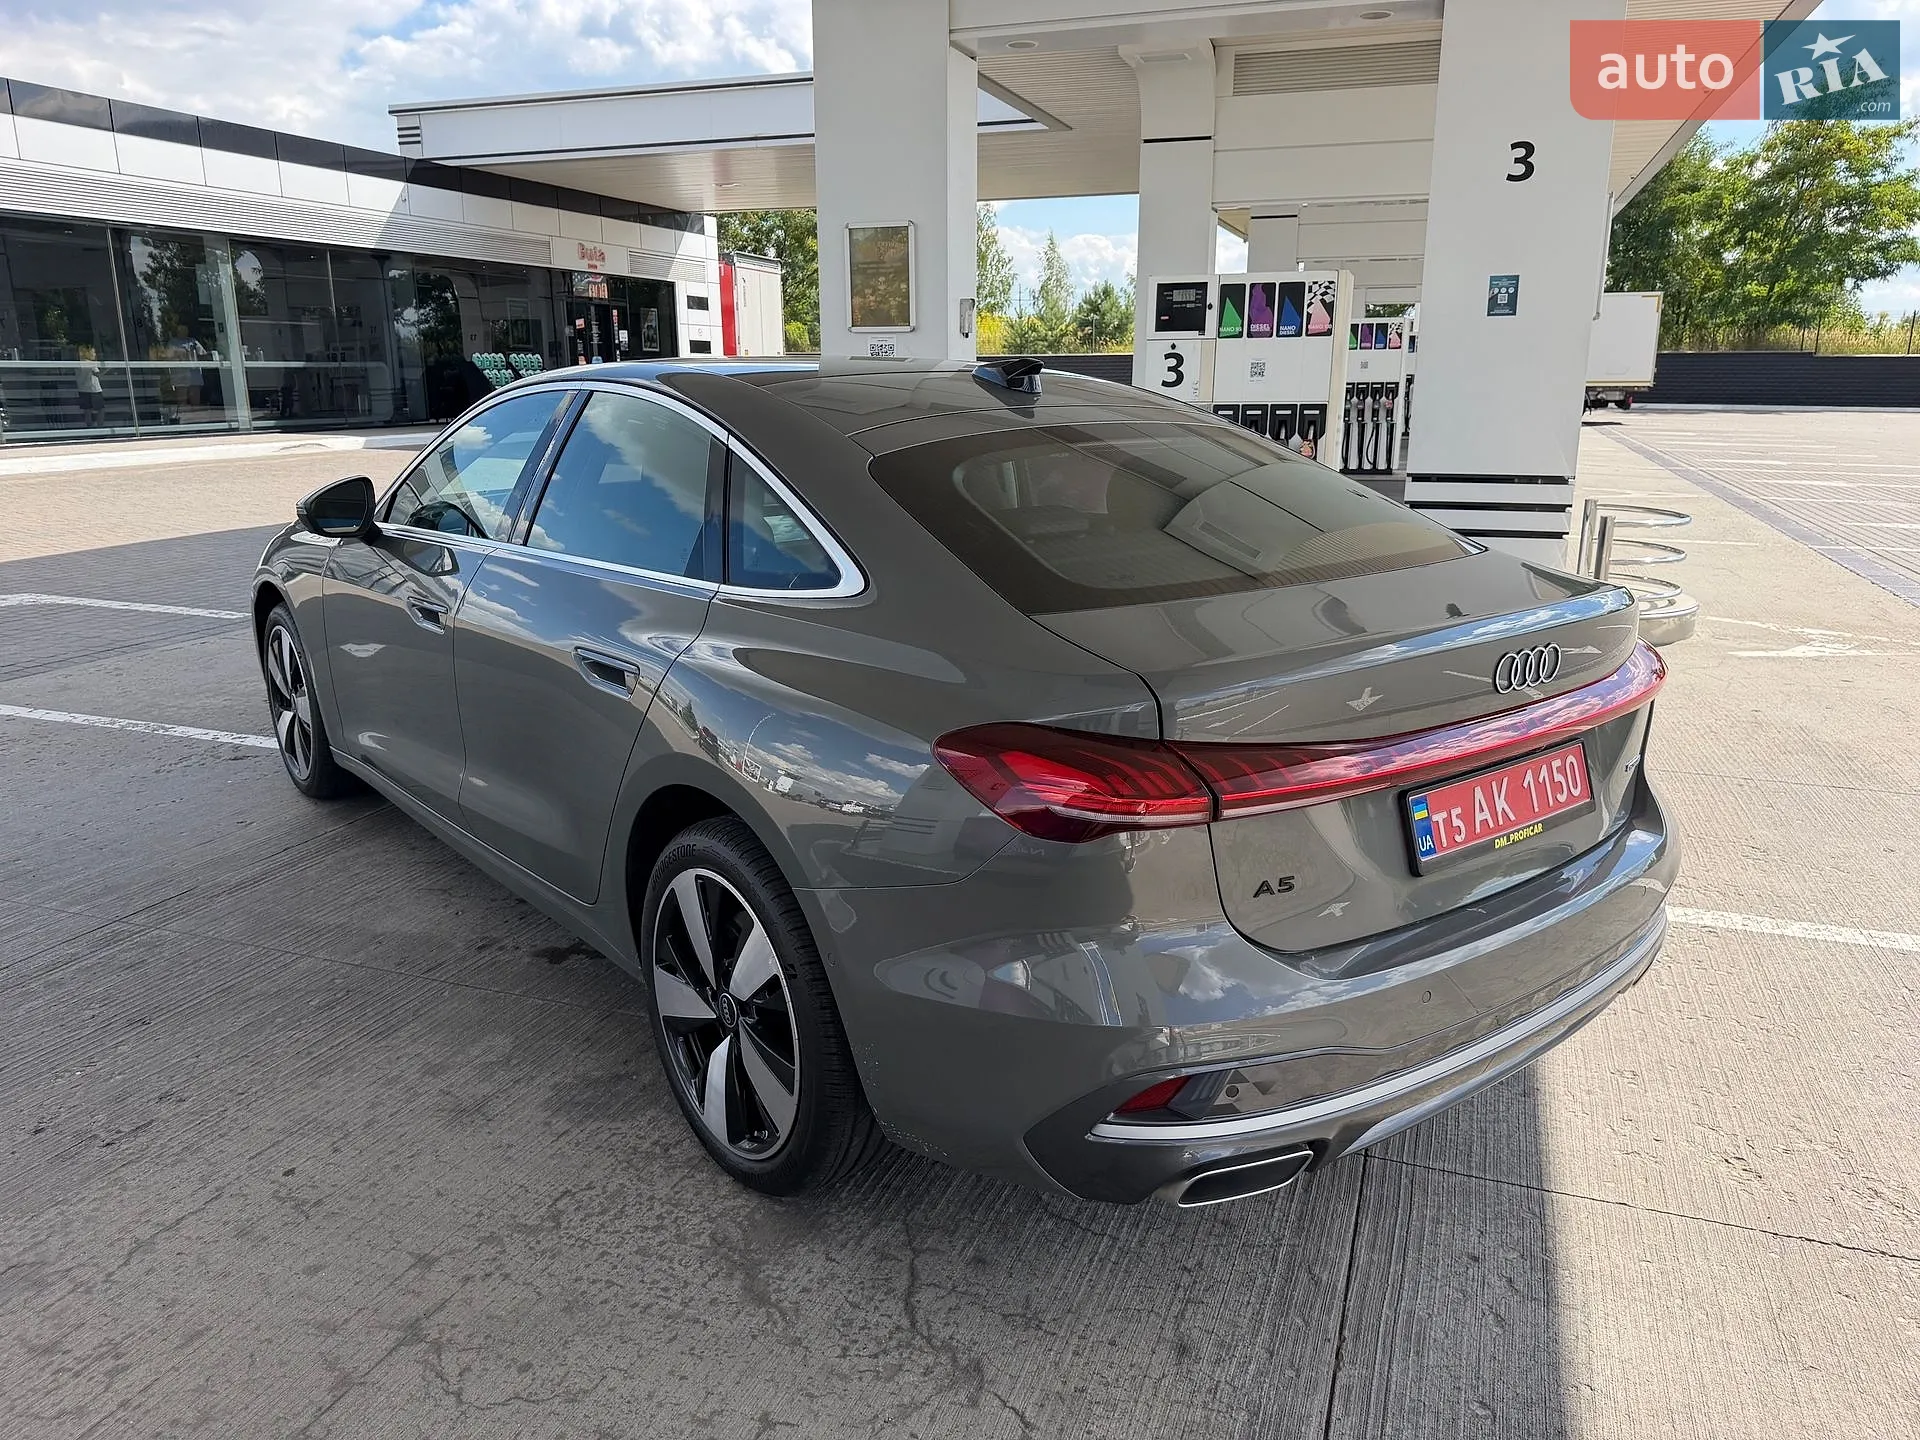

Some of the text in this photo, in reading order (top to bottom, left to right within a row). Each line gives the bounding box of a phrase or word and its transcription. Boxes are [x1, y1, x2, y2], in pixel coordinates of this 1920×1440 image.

[1505, 140, 1536, 182] 3
[1160, 351, 1185, 388] 3
[1432, 754, 1582, 848] T5 AK 1150
[1418, 834, 1434, 852] UA
[1494, 823, 1544, 849] DM_PROFICAR
[1252, 875, 1295, 899] A5
